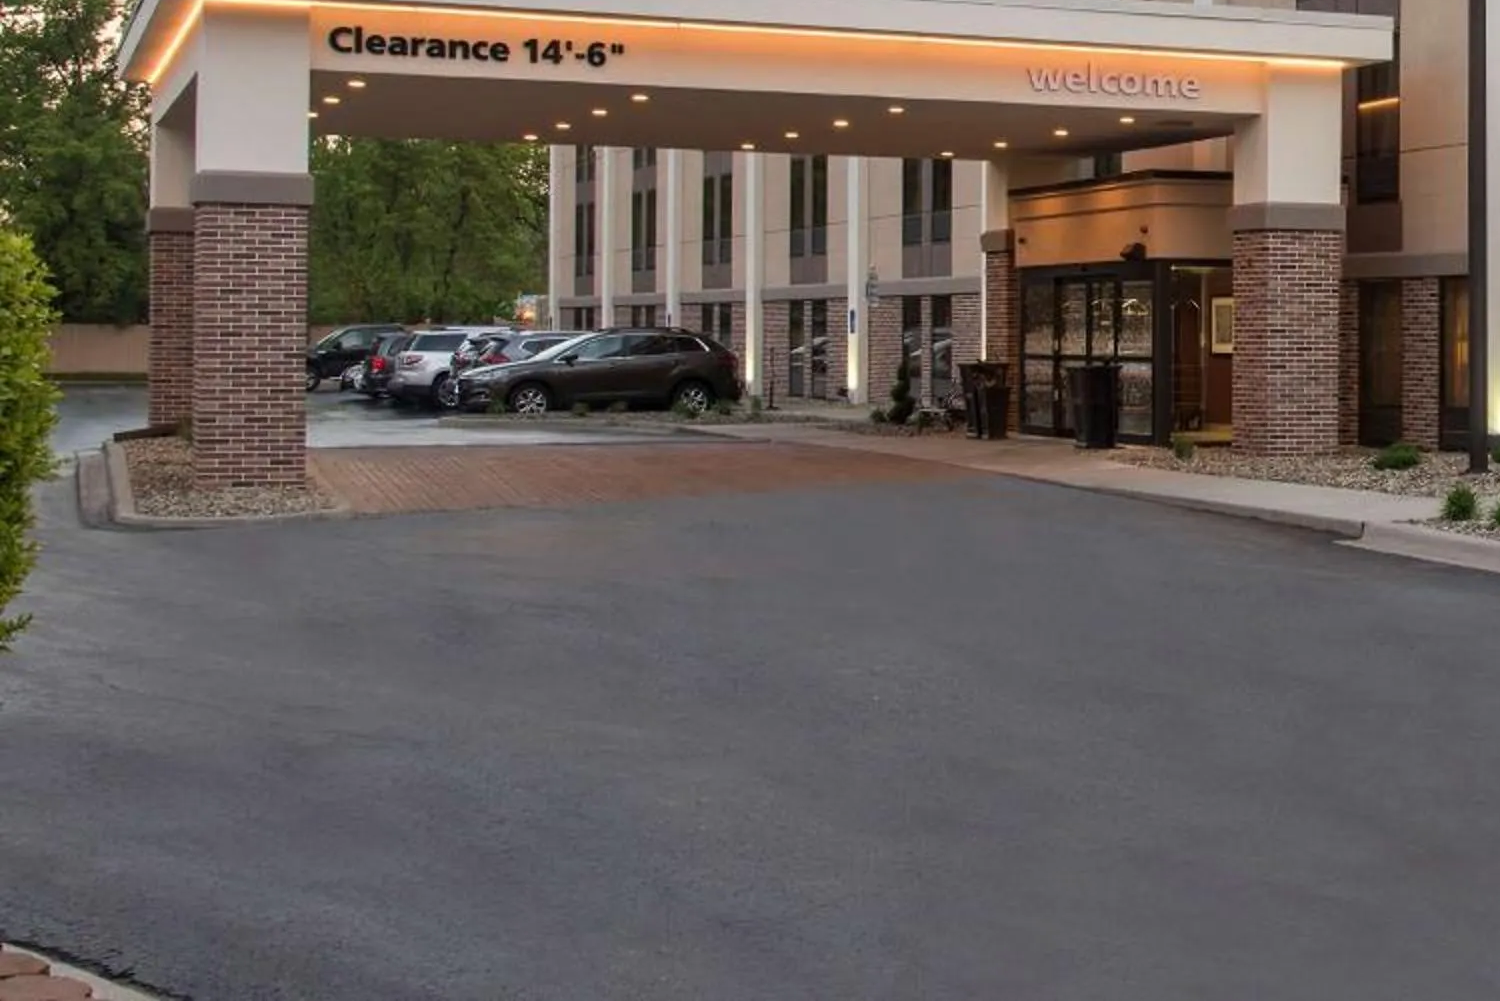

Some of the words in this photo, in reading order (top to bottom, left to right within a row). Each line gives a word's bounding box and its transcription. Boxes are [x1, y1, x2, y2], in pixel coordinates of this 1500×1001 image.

[328, 26, 511, 62] Clearance
[523, 38, 625, 67] 14'-6"
[1027, 61, 1201, 99] welcome
